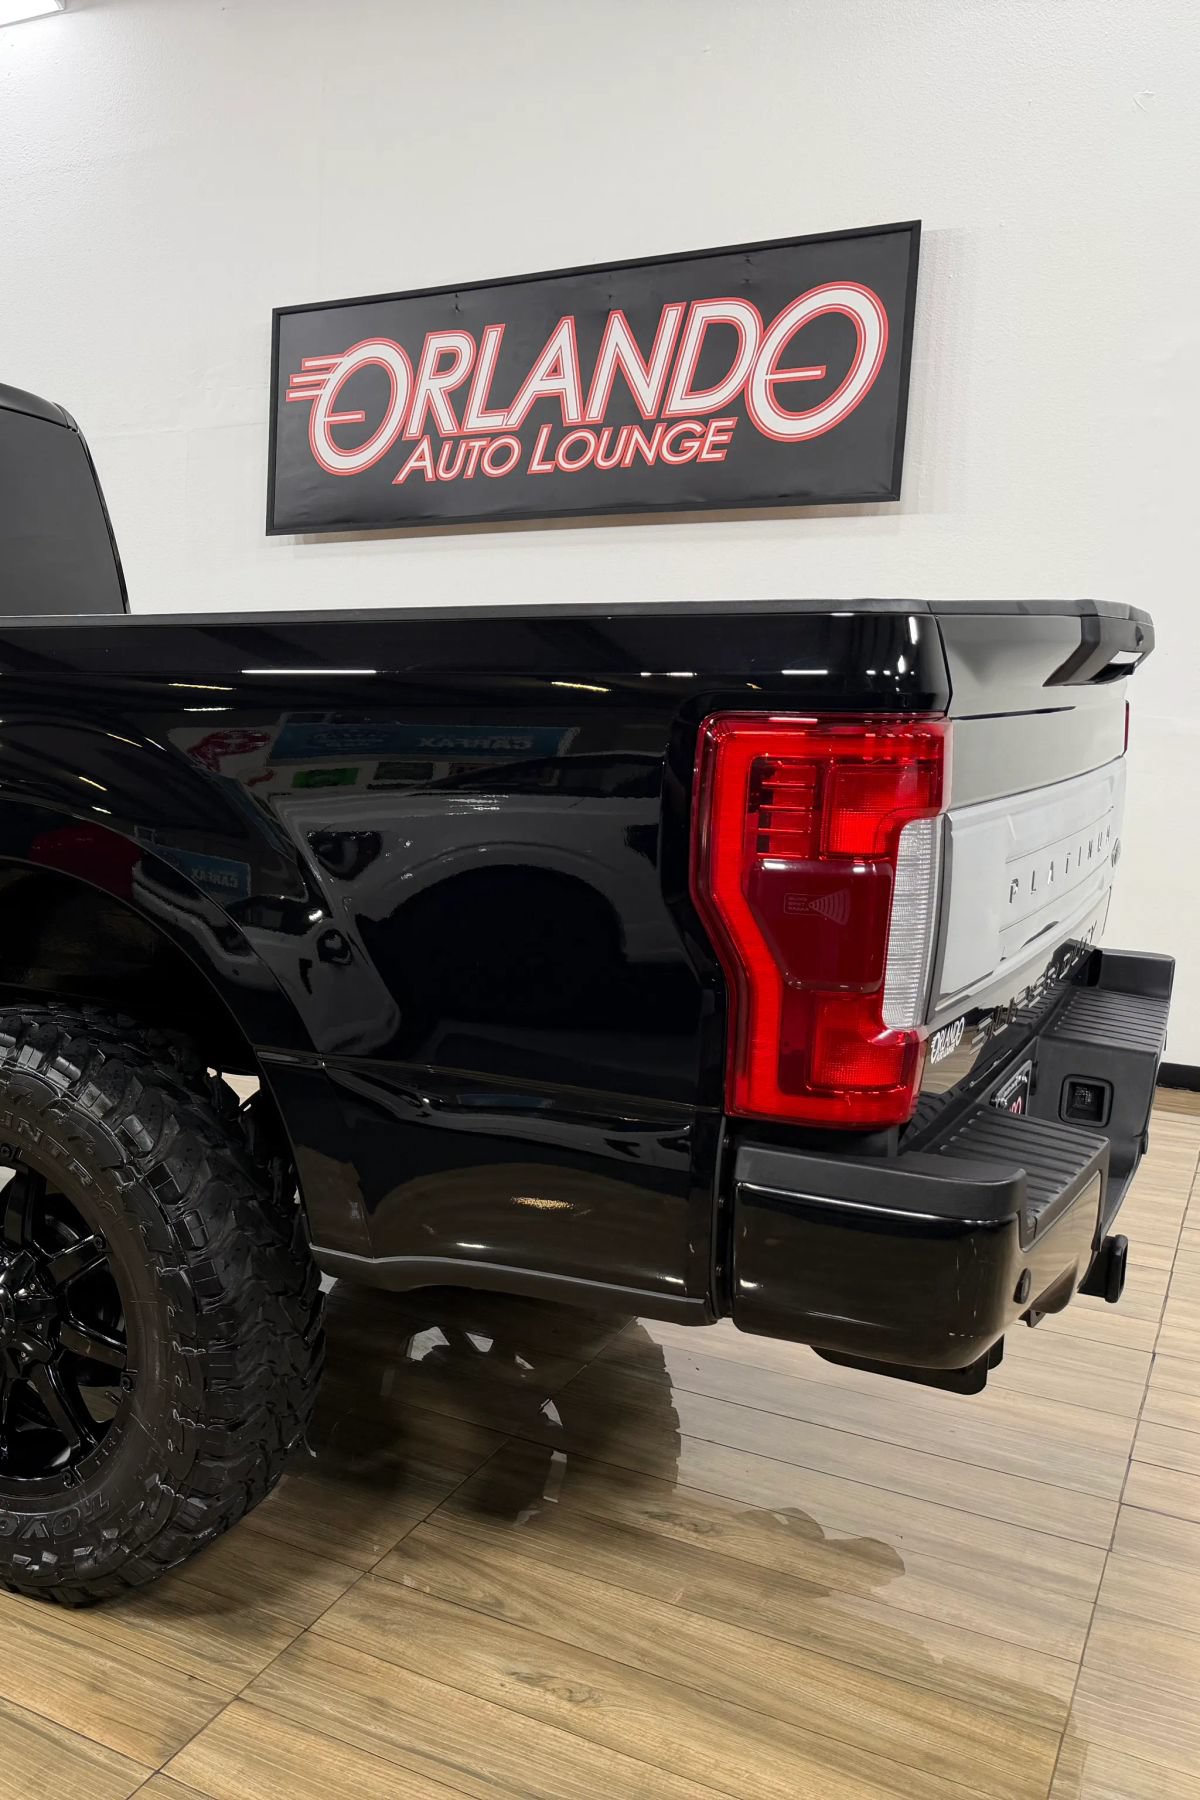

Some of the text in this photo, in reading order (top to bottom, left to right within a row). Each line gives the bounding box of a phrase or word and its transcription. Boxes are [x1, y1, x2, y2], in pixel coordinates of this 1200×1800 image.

[286, 281, 889, 475] ORLANDO
[392, 416, 738, 484] AUTO LOUNGE
